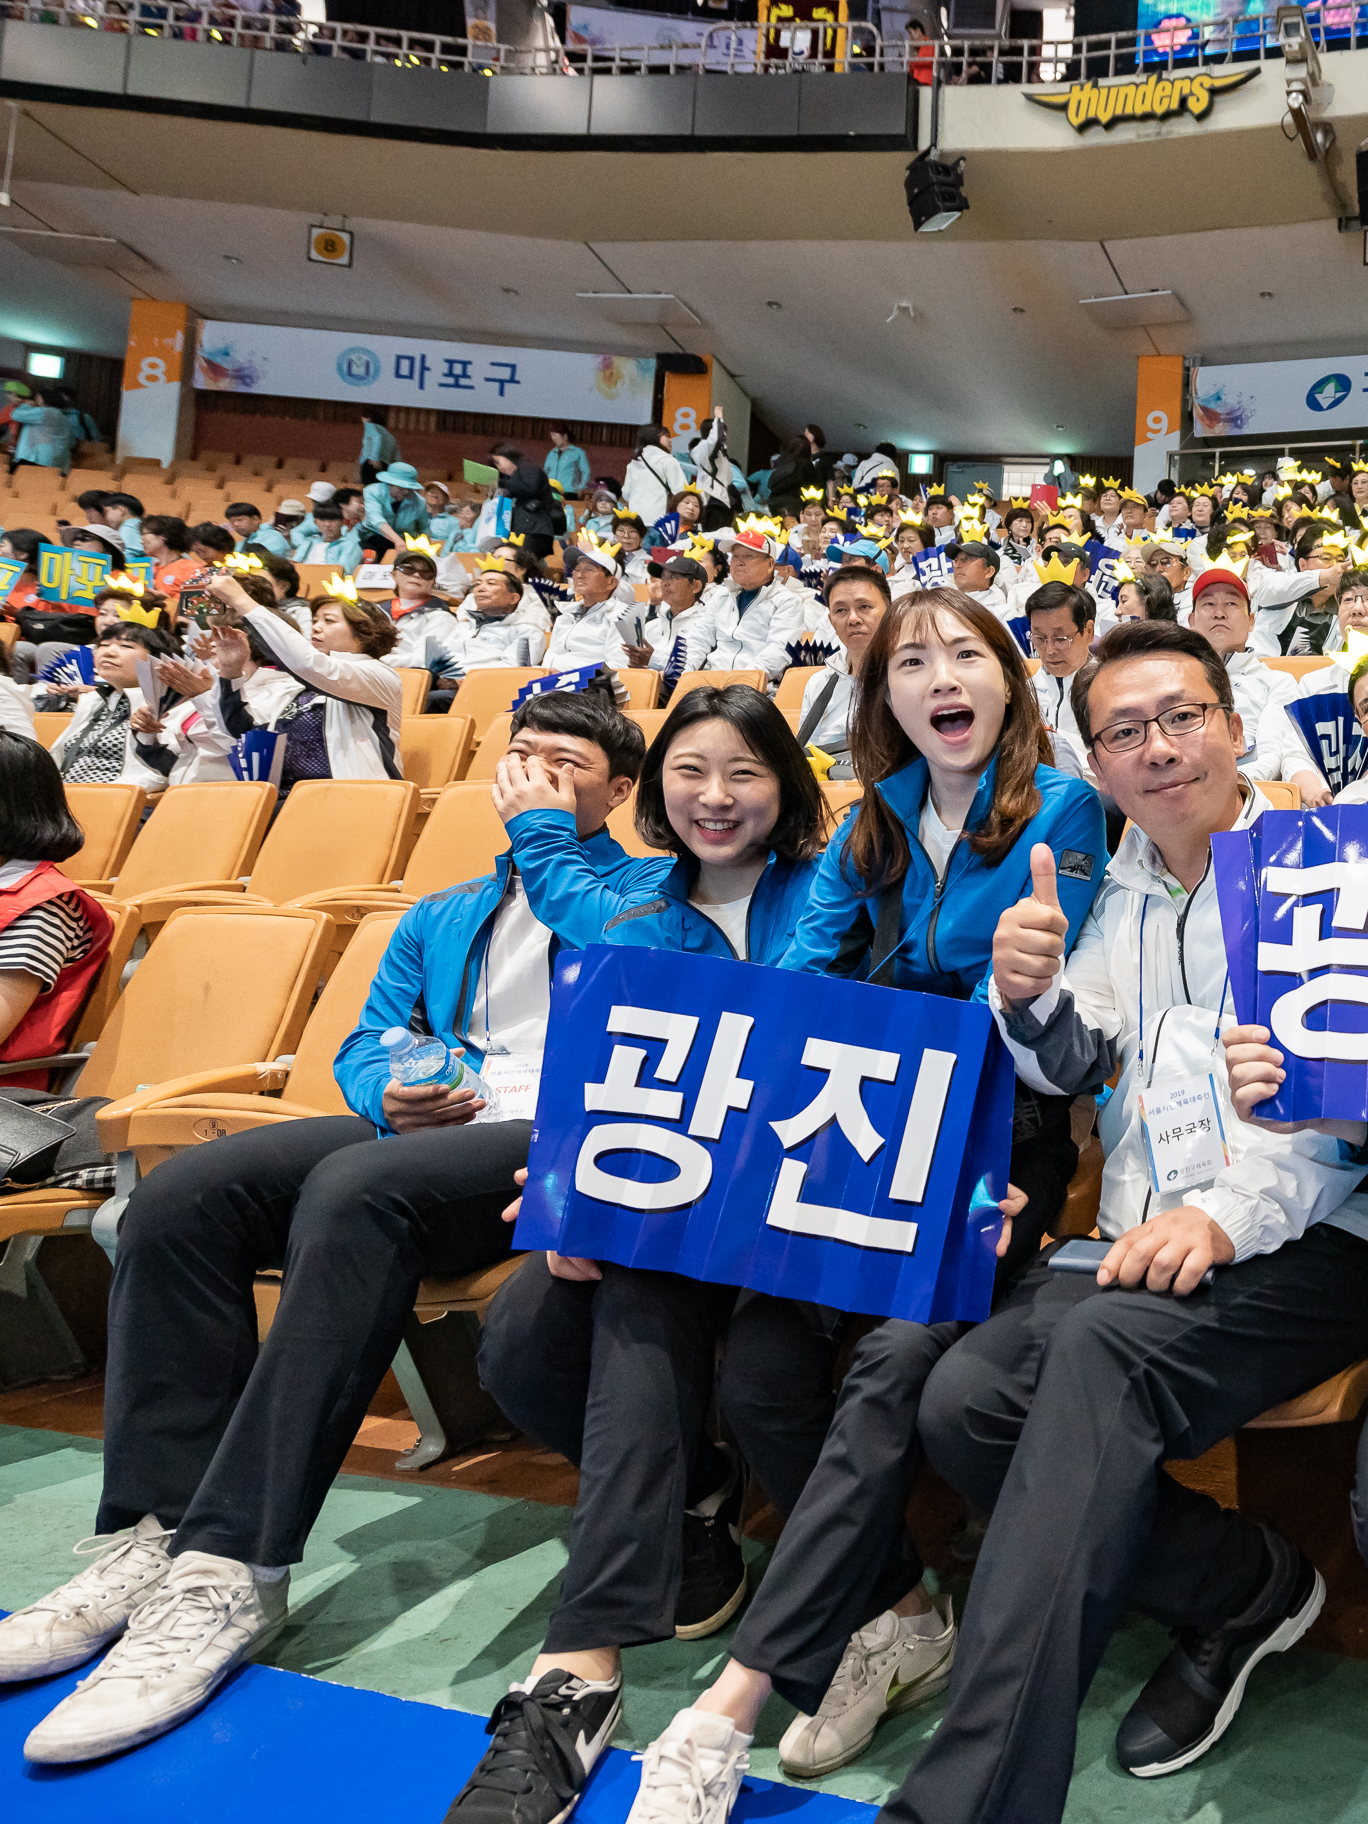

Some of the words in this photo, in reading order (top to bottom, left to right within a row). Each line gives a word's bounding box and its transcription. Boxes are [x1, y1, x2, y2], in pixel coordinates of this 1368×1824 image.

[1067, 72, 1213, 127] thunders
[137, 357, 167, 388] 8
[393, 353, 521, 397] 마포구
[673, 406, 697, 437] 8
[1146, 410, 1168, 440] 9
[40, 551, 108, 601] 마포
[495, 1084, 532, 1094] STAFF
[1169, 1089, 1185, 1100] 2019
[575, 1005, 957, 1253] 광진
[1157, 1117, 1211, 1145] 사무국장
